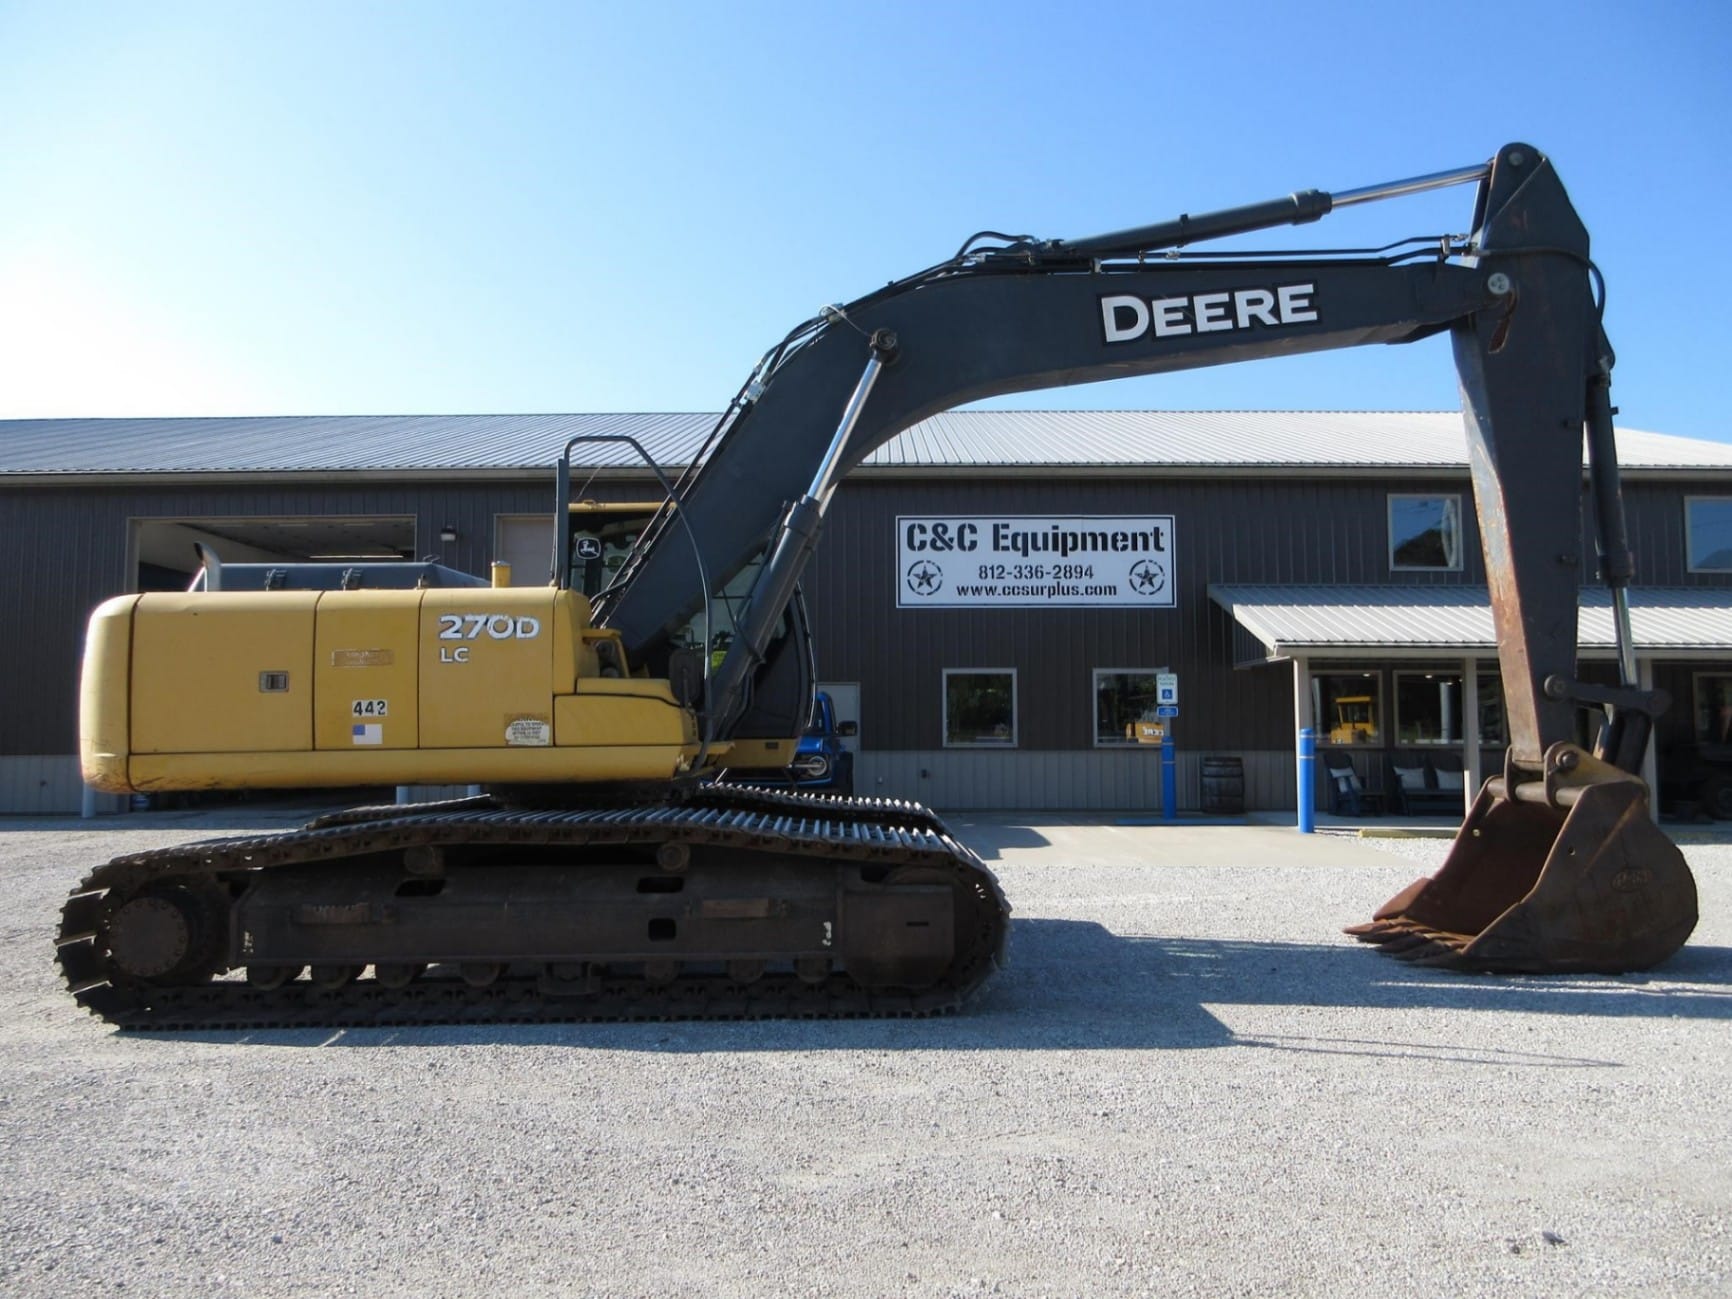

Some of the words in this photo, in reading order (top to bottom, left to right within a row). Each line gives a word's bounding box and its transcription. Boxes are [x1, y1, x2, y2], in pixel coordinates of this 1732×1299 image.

[1101, 283, 1318, 343] DEERE
[906, 522, 978, 552] C&C
[992, 523, 1165, 557] Equipment
[978, 564, 1094, 580] 812-336-2894
[956, 581, 1117, 599] www.ccsurplus.com
[439, 614, 540, 639] 270D
[440, 647, 469, 662] LC
[353, 700, 386, 716] 442
